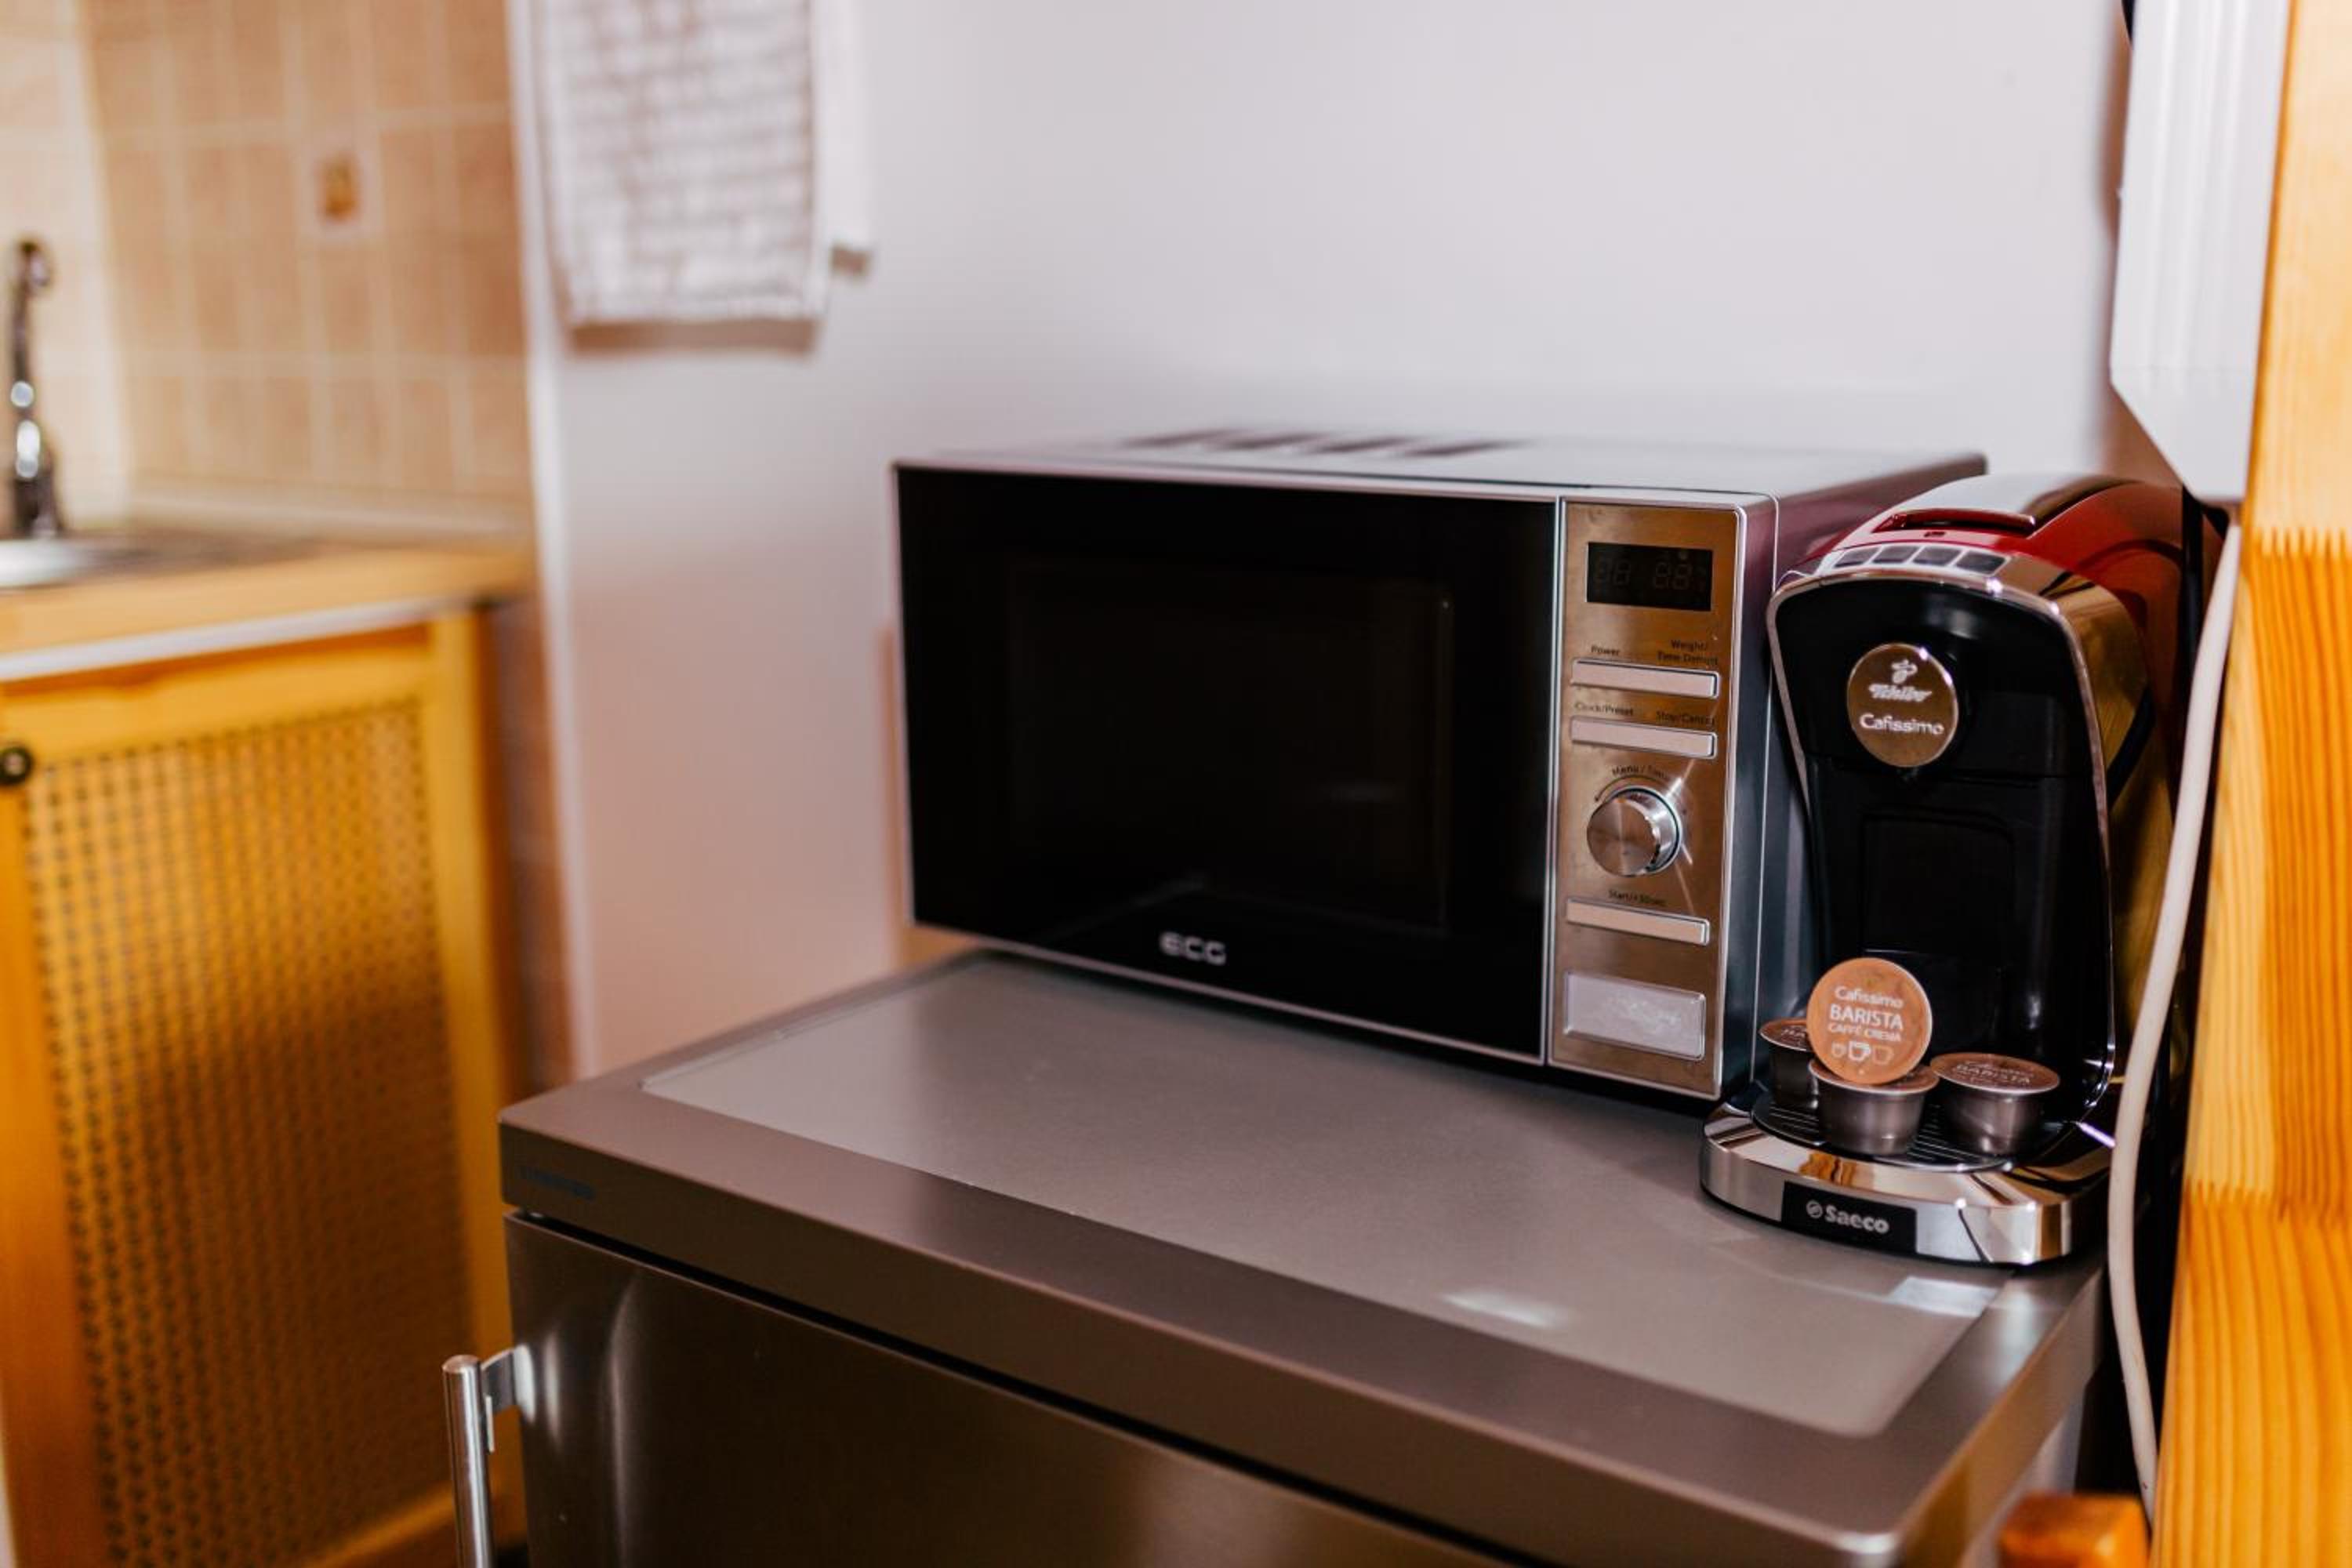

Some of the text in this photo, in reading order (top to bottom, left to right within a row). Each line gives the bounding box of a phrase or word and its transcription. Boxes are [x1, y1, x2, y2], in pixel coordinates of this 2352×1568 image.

[1591, 644, 1620, 656] Power
[1859, 713, 1945, 735] Cafissimo
[1835, 985, 1904, 1009] Cafissimo
[1829, 1003, 1904, 1032] BARISTA
[1864, 1027, 1902, 1042] CREMA
[1824, 1204, 1890, 1234] Saeco
